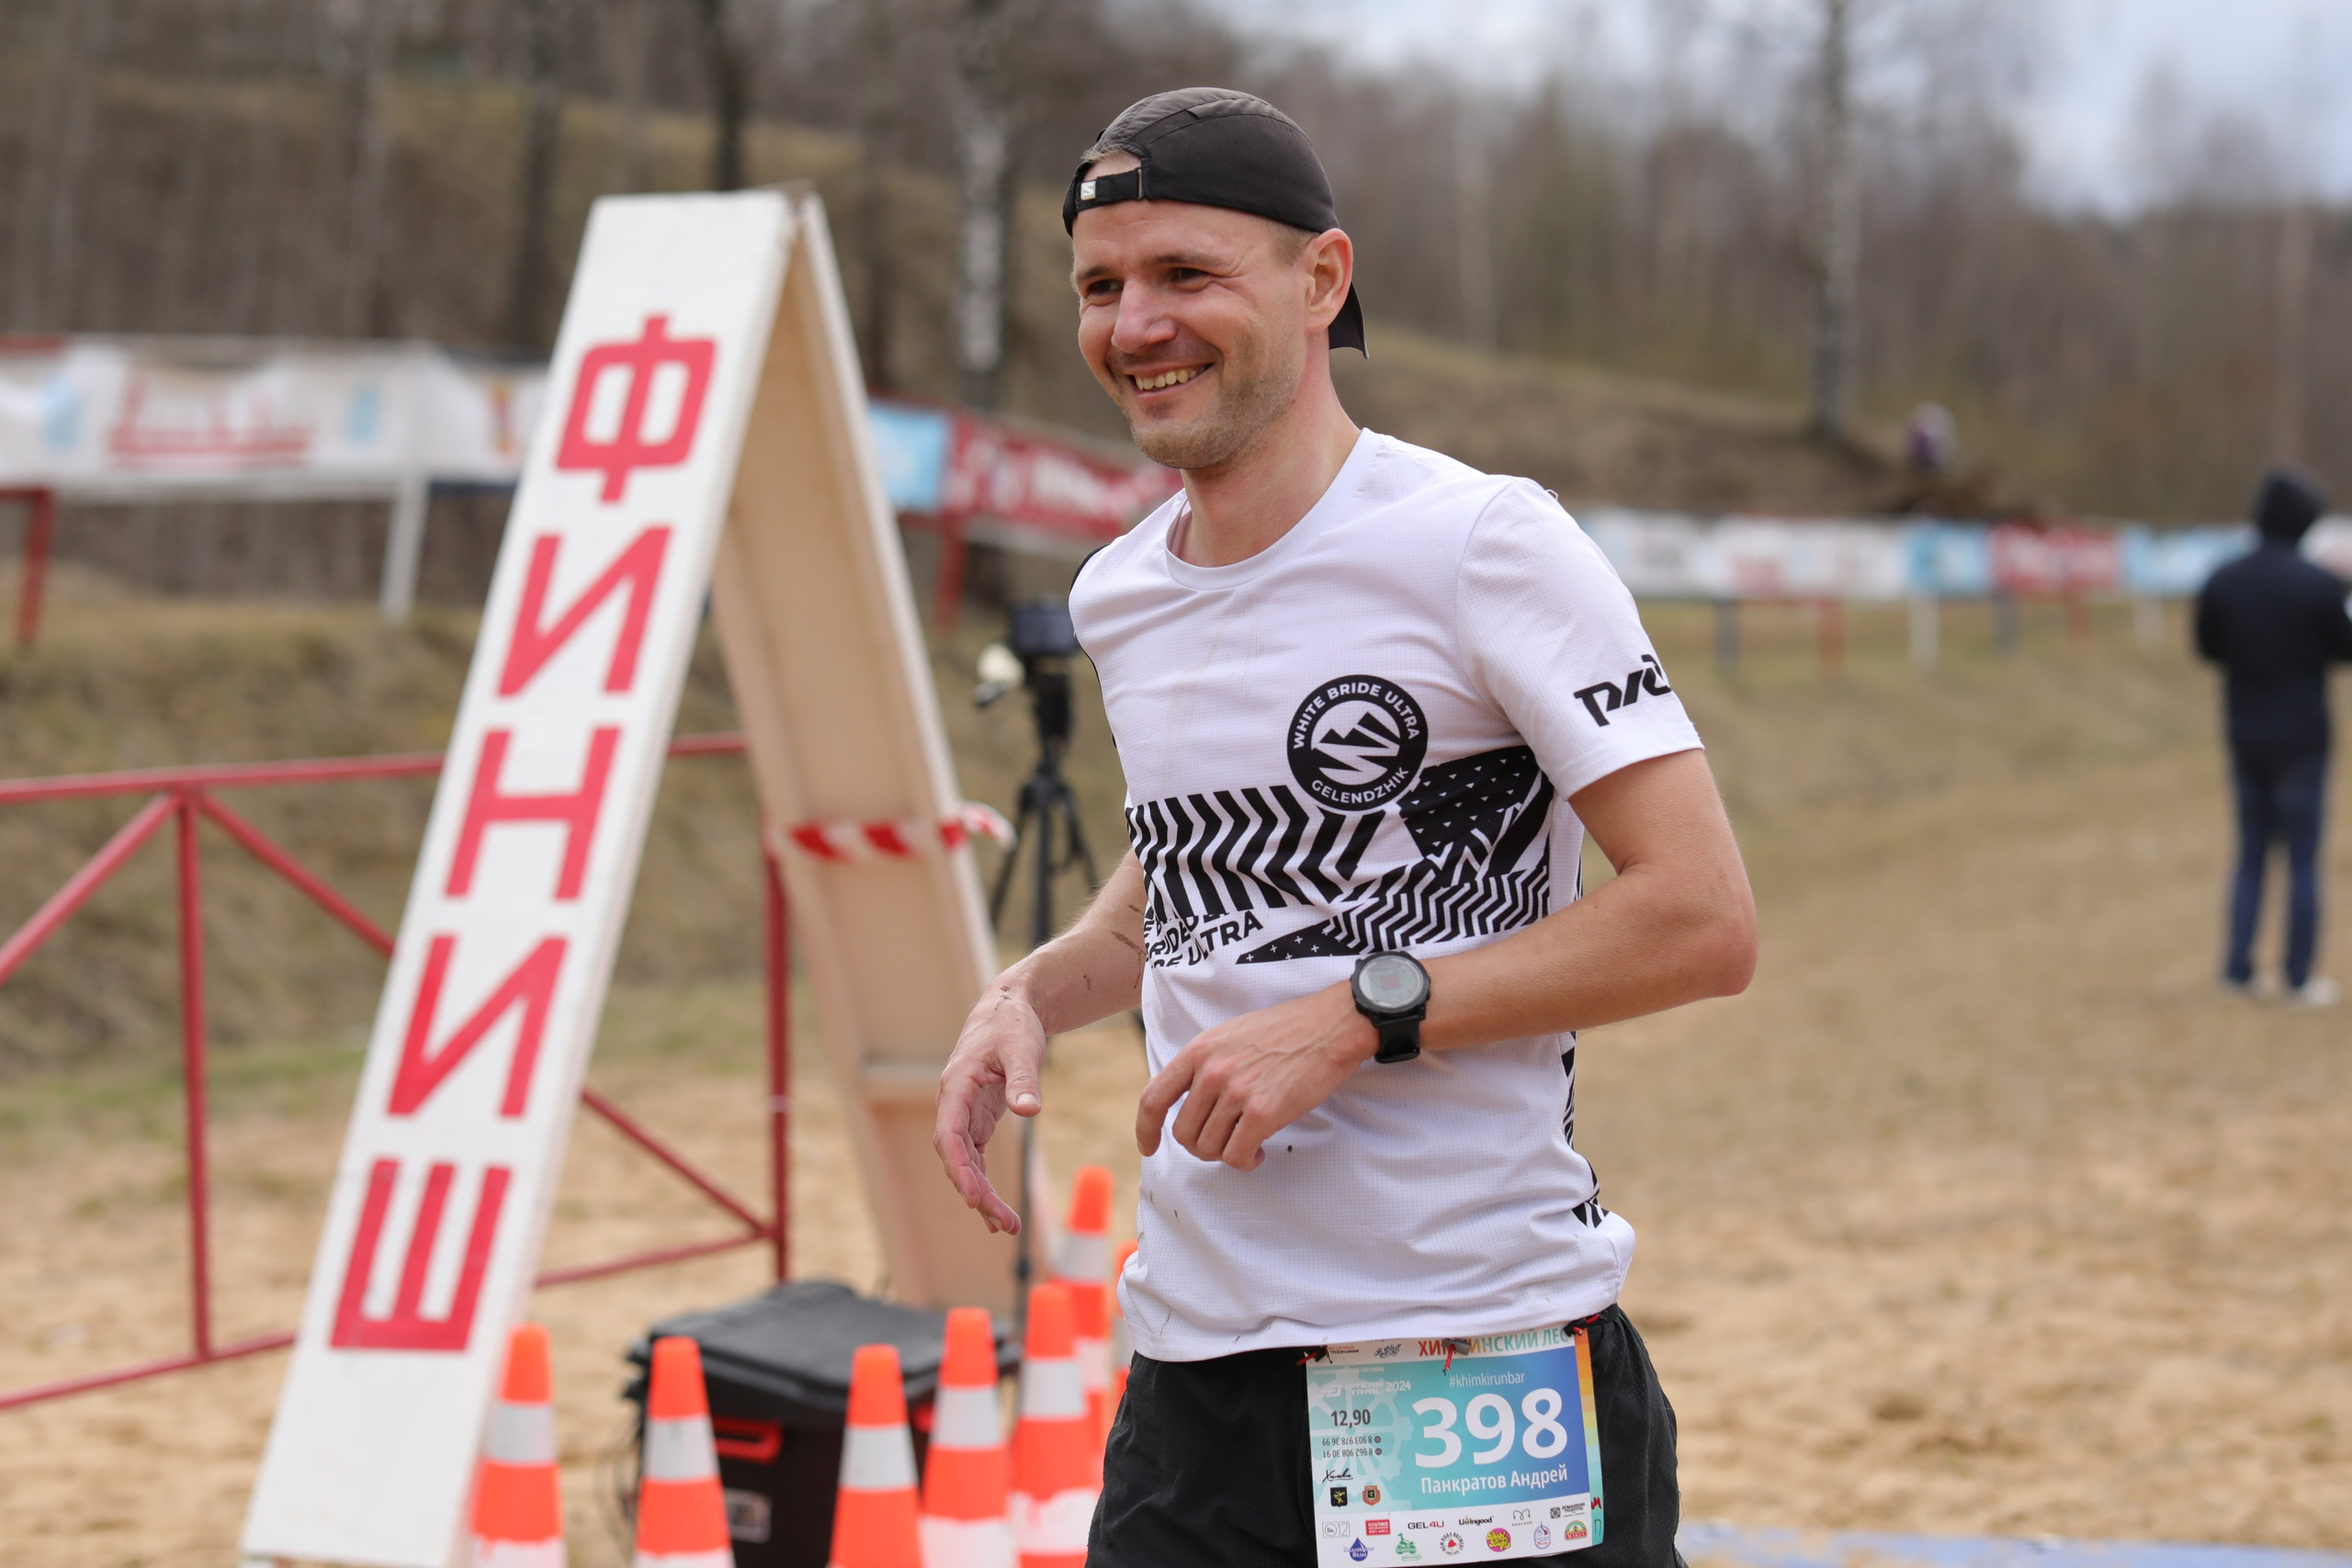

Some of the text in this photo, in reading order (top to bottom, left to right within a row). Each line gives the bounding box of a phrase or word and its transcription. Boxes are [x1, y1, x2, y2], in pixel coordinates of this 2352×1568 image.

[1293, 682, 1420, 750] WHITE BRIDE ULTRA
[1311, 766, 1409, 805] GELENDZHIK
[328, 313, 718, 1352] ФИНИШ
[1543, 1326, 1570, 1347] ЛЕС
[1449, 1371, 1526, 1388] #khimkirunbar
[1345, 1381, 1411, 1393] DREAM 2024
[1351, 1388, 1380, 1396] TRAIL
[1330, 1408, 1371, 1429] 12,90
[1411, 1388, 1568, 1469] 398
[1322, 1438, 1331, 1447] 99
[1332, 1437, 1340, 1446] 36
[1341, 1437, 1353, 1445] 978
[1355, 1436, 1367, 1444] 903
[1323, 1450, 1331, 1459] 91
[1332, 1450, 1340, 1458] 30
[1342, 1450, 1354, 1458] 908
[1355, 1449, 1368, 1457] 962
[1421, 1464, 1567, 1496] Панкратов Андрей
[1408, 1520, 1445, 1530] GEL4U
